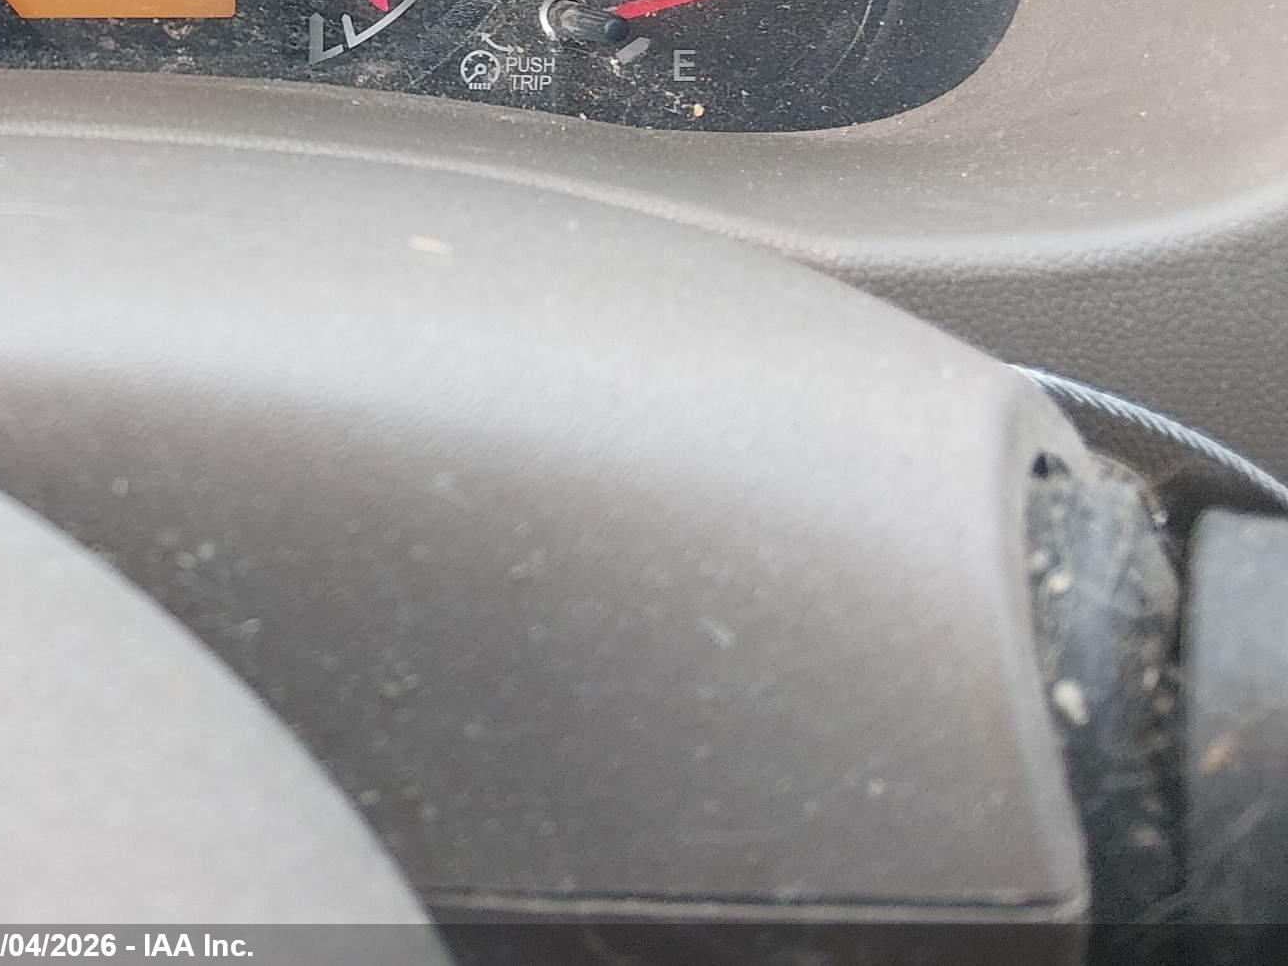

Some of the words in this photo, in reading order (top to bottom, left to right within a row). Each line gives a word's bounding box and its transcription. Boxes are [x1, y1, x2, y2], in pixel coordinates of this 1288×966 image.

[506, 56, 556, 74] PUSH
[673, 50, 695, 81] E
[511, 74, 552, 91] TRIP
